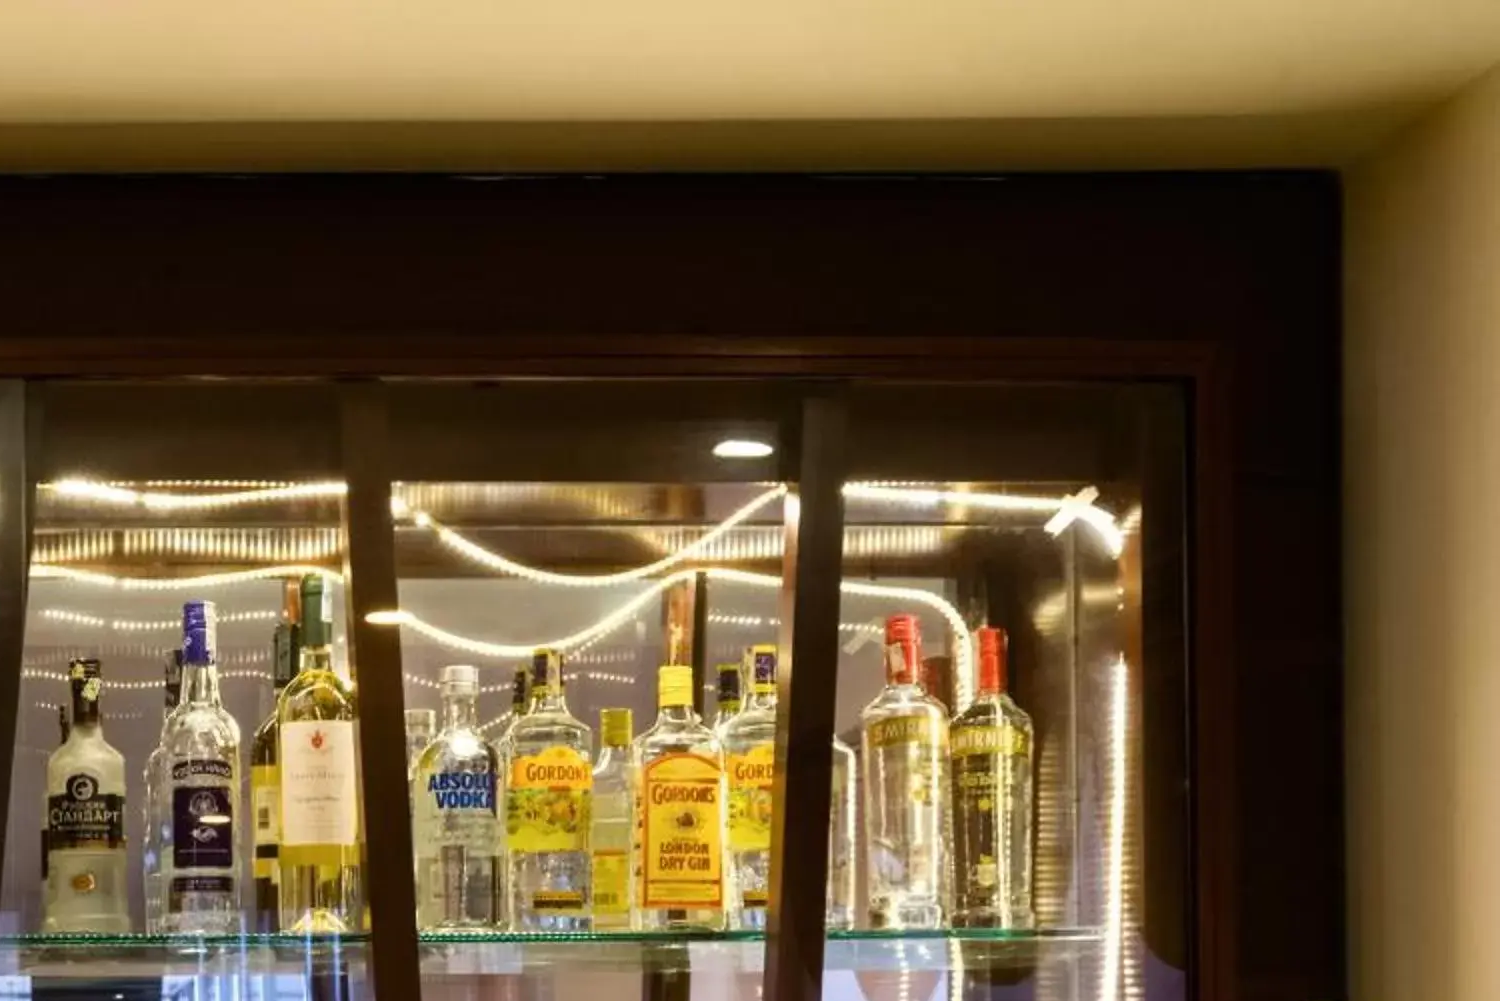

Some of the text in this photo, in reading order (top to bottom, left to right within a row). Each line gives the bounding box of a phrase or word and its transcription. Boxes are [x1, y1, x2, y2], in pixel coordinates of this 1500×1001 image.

[950, 728, 1025, 752] SMIRNFF
[660, 856, 711, 871] DRY GIN
